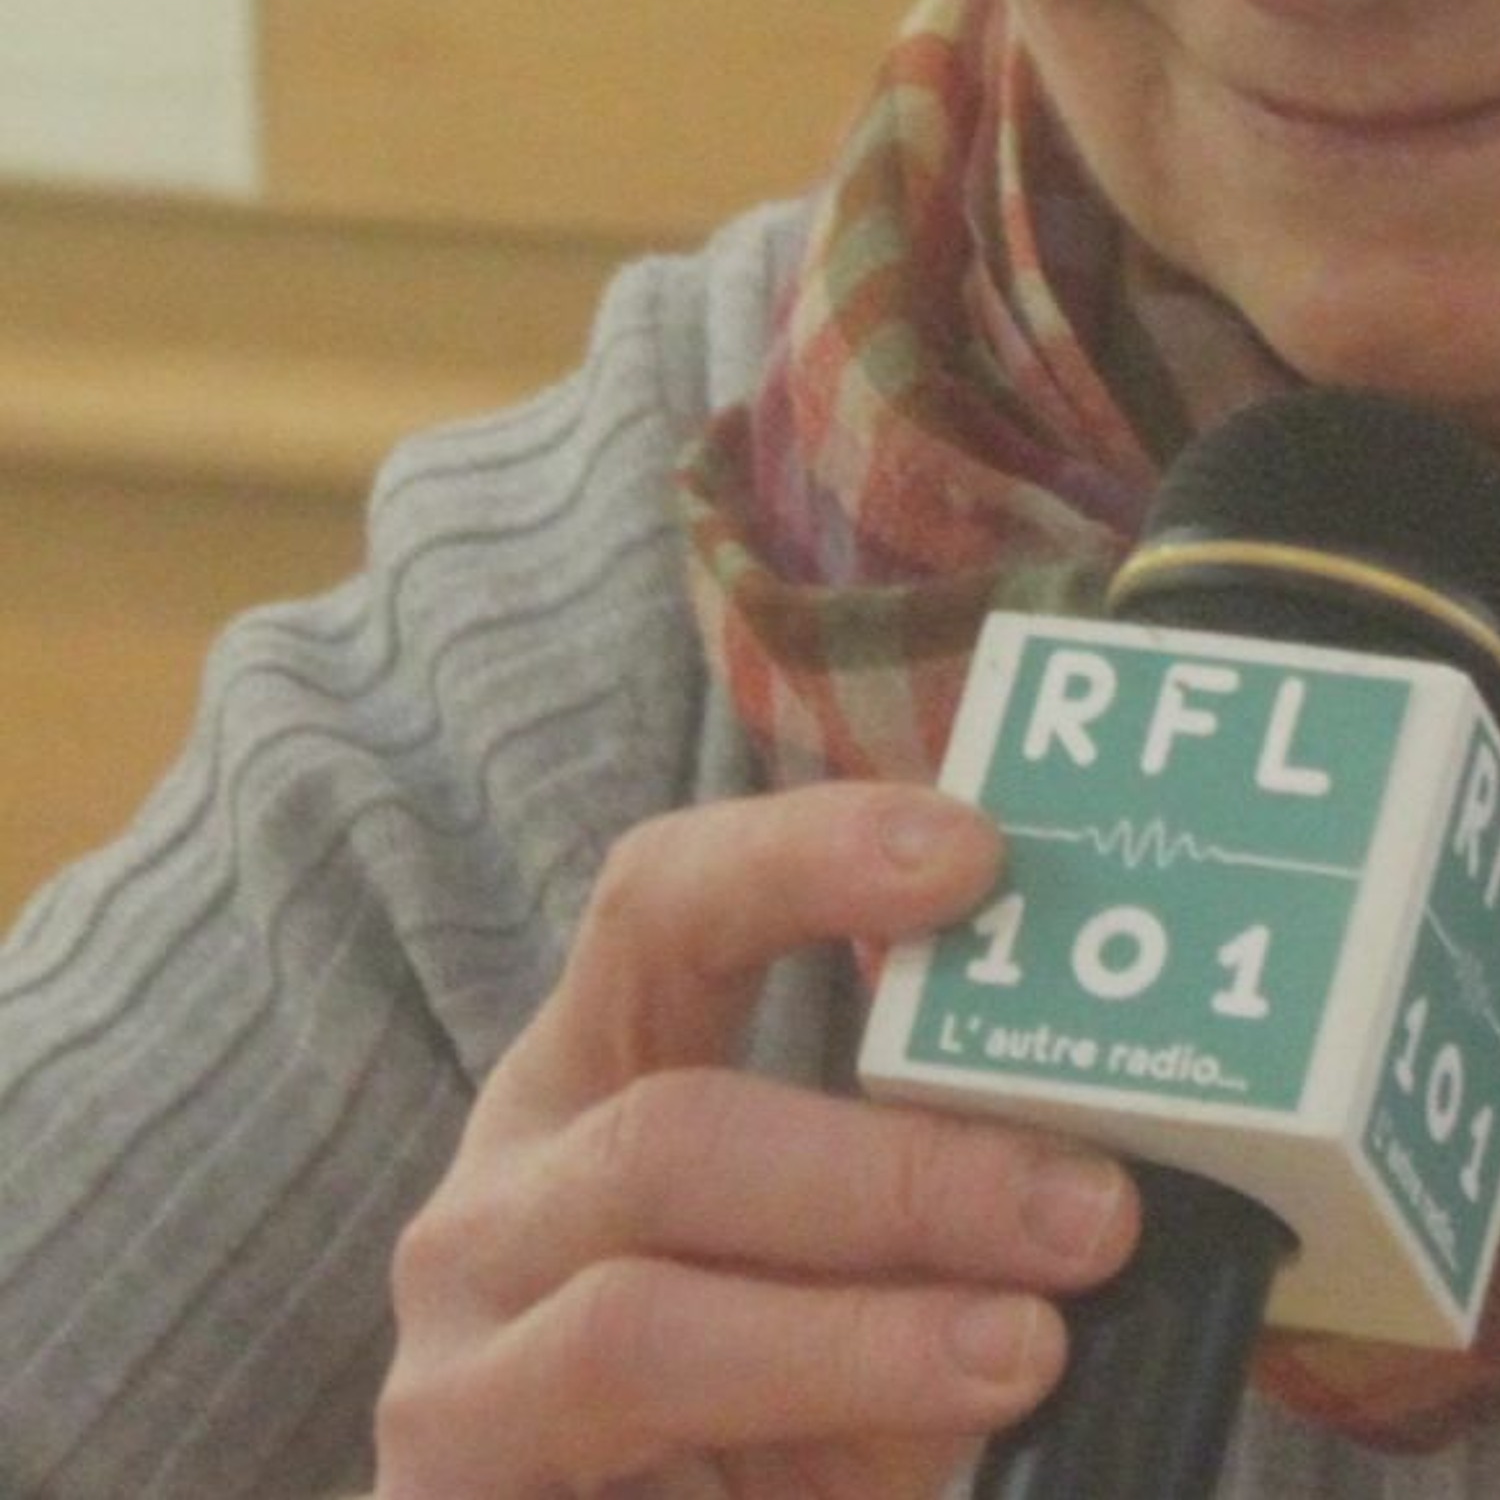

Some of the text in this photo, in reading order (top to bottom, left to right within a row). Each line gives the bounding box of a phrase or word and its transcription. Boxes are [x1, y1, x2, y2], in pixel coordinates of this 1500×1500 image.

[1022, 648, 1332, 797] RFL
[965, 892, 1273, 1019] 101
[985, 1022, 1098, 1069] autre
[1394, 996, 1493, 1202] 101
